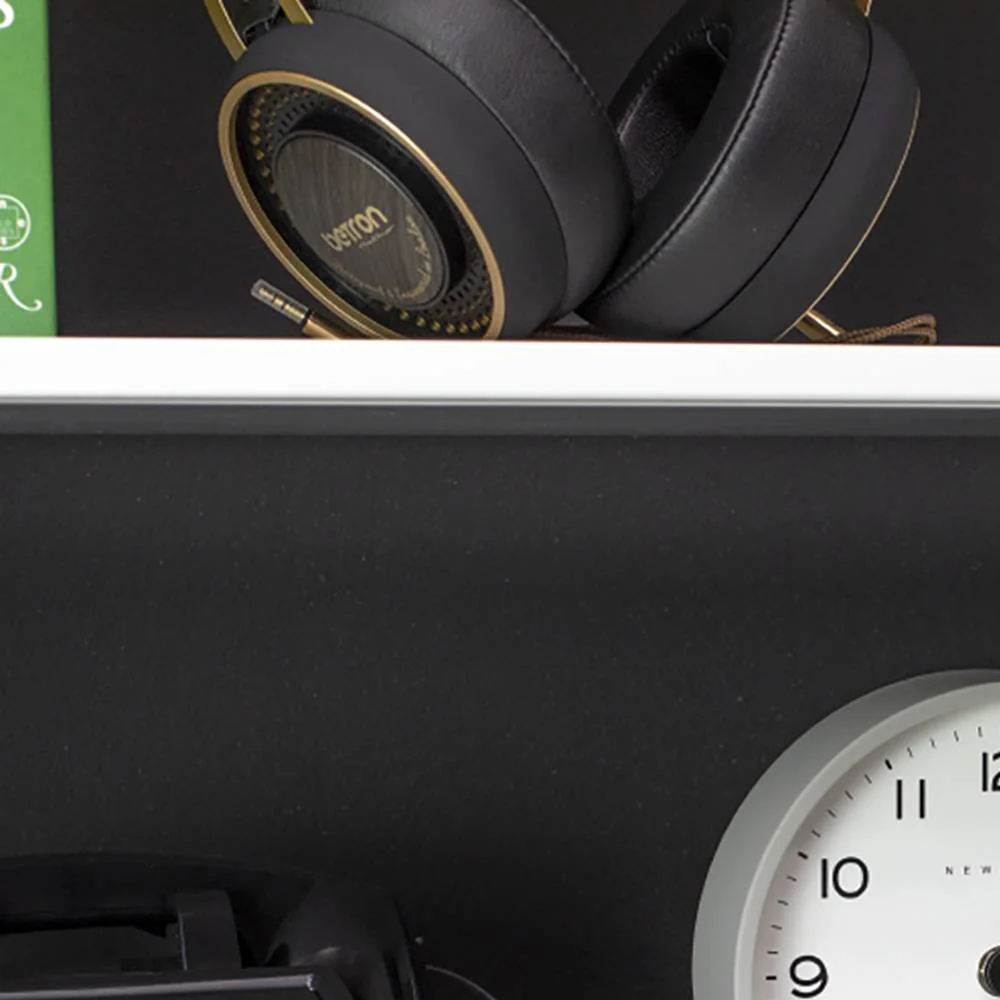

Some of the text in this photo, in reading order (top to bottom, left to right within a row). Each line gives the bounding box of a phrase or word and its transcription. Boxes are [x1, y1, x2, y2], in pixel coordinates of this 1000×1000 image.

[896, 779, 926, 819] 11
[820, 856, 869, 899] 10
[789, 955, 828, 998] 9
